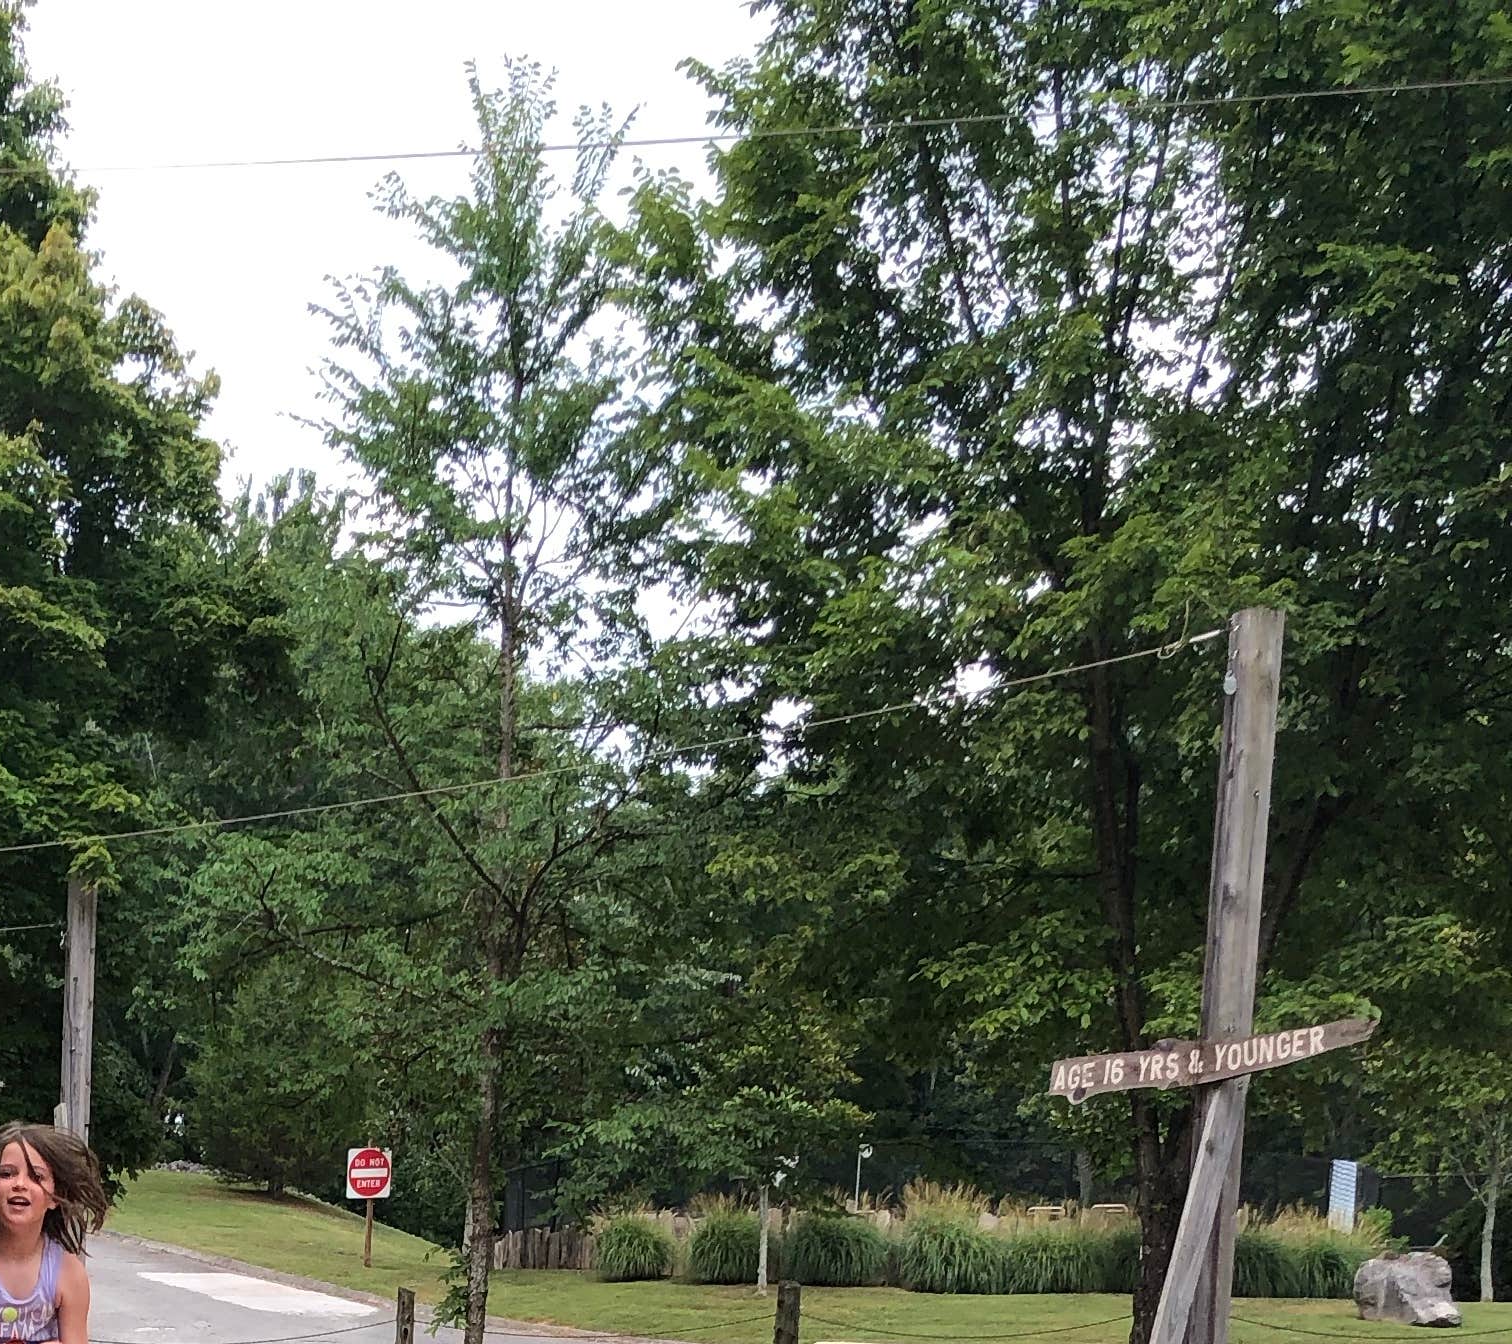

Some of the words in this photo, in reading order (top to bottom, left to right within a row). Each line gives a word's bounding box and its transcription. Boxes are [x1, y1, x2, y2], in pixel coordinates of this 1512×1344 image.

[1053, 1062, 1096, 1090] AGE
[1103, 1058, 1125, 1085] 16
[1138, 1053, 1180, 1082] YRS
[1188, 1049, 1204, 1074] &
[1214, 1026, 1326, 1072] YOUNGER
[354, 1159, 366, 1167] DO
[369, 1158, 385, 1167] NOT
[356, 1179, 381, 1189] ENTER
